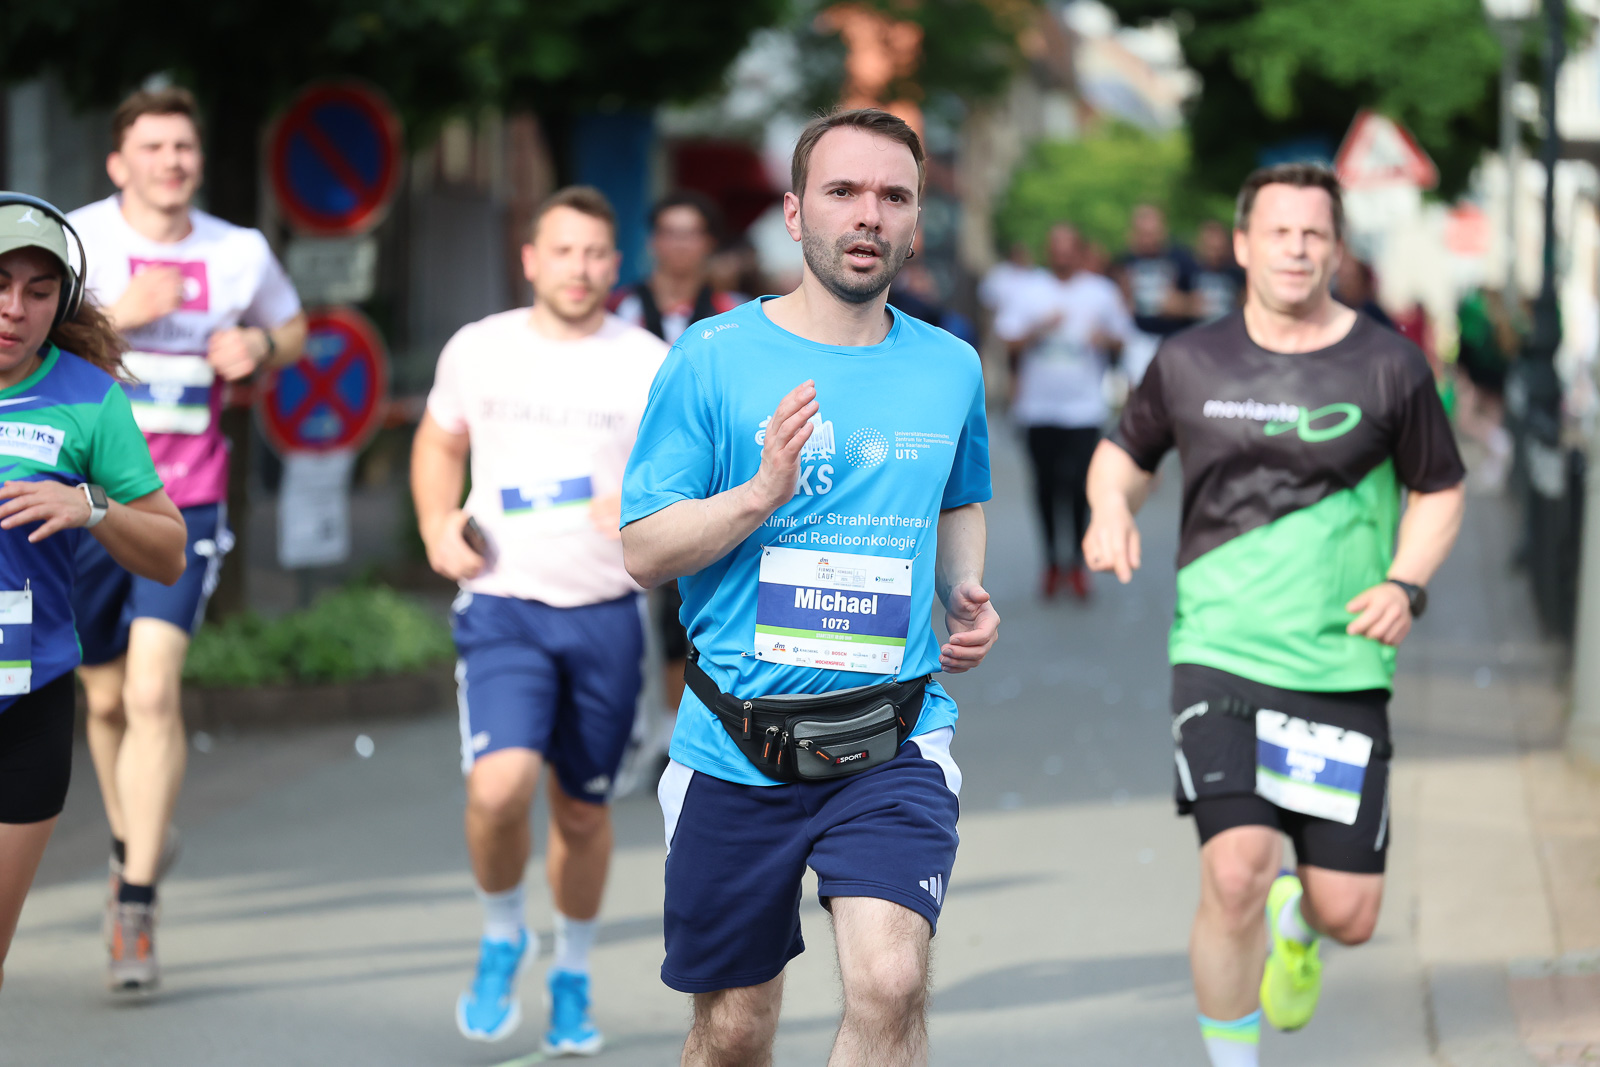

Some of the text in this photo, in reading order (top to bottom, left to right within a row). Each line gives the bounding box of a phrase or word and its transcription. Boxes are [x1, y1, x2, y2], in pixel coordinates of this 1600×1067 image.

[714, 323, 740, 332] JAKO
[895, 449, 919, 460] UTS
[779, 531, 917, 551] und Radioonkologie
[794, 587, 878, 615] Michael
[821, 617, 850, 631] 1073
